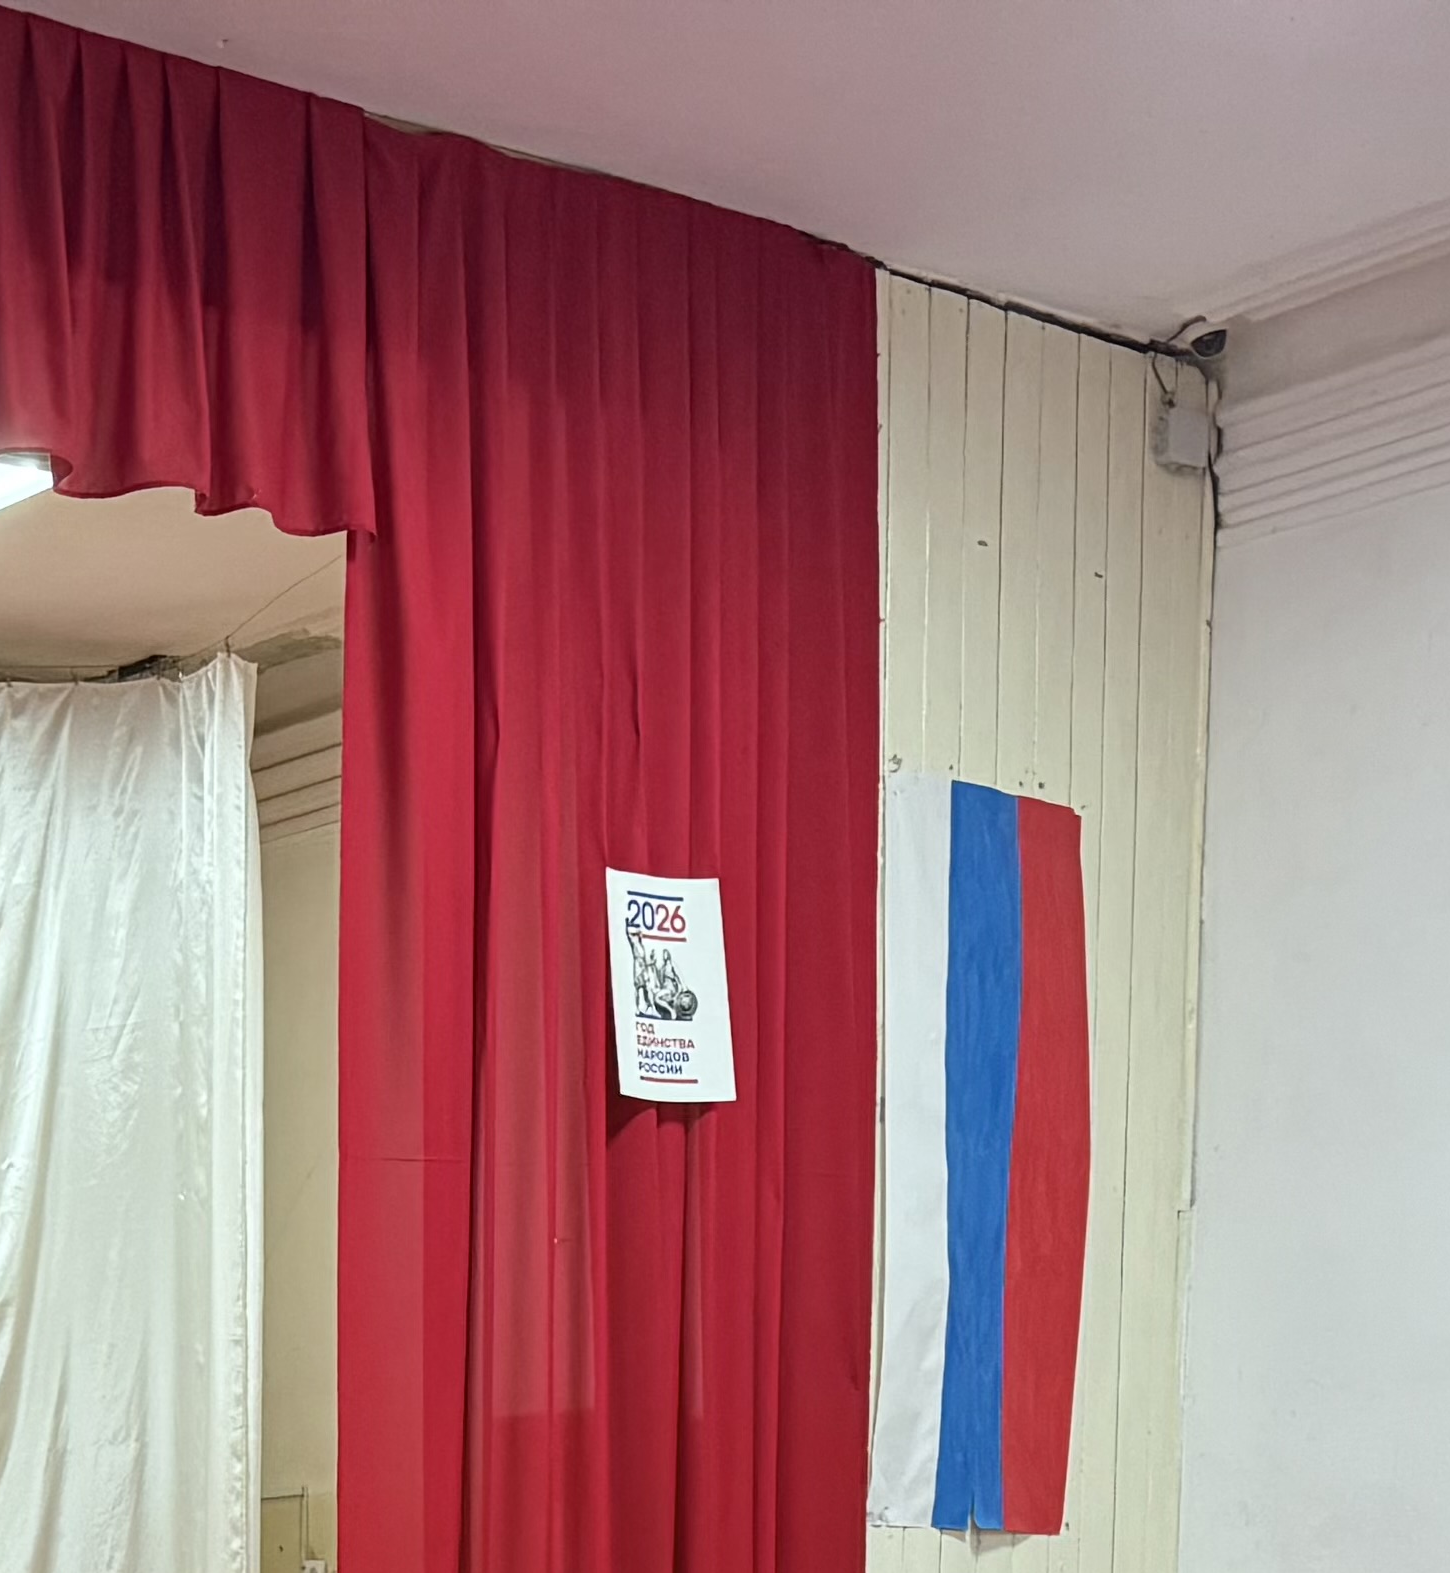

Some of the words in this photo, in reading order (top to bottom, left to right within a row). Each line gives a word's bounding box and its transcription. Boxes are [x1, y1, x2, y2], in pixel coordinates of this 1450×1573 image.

[627, 900, 686, 933] 2026
[636, 1021, 655, 1034] ГОД
[637, 1035, 695, 1049] ЕДИНСТВА
[637, 1048, 690, 1063] НАРОДОВ
[639, 1061, 683, 1075] РОССИИ
